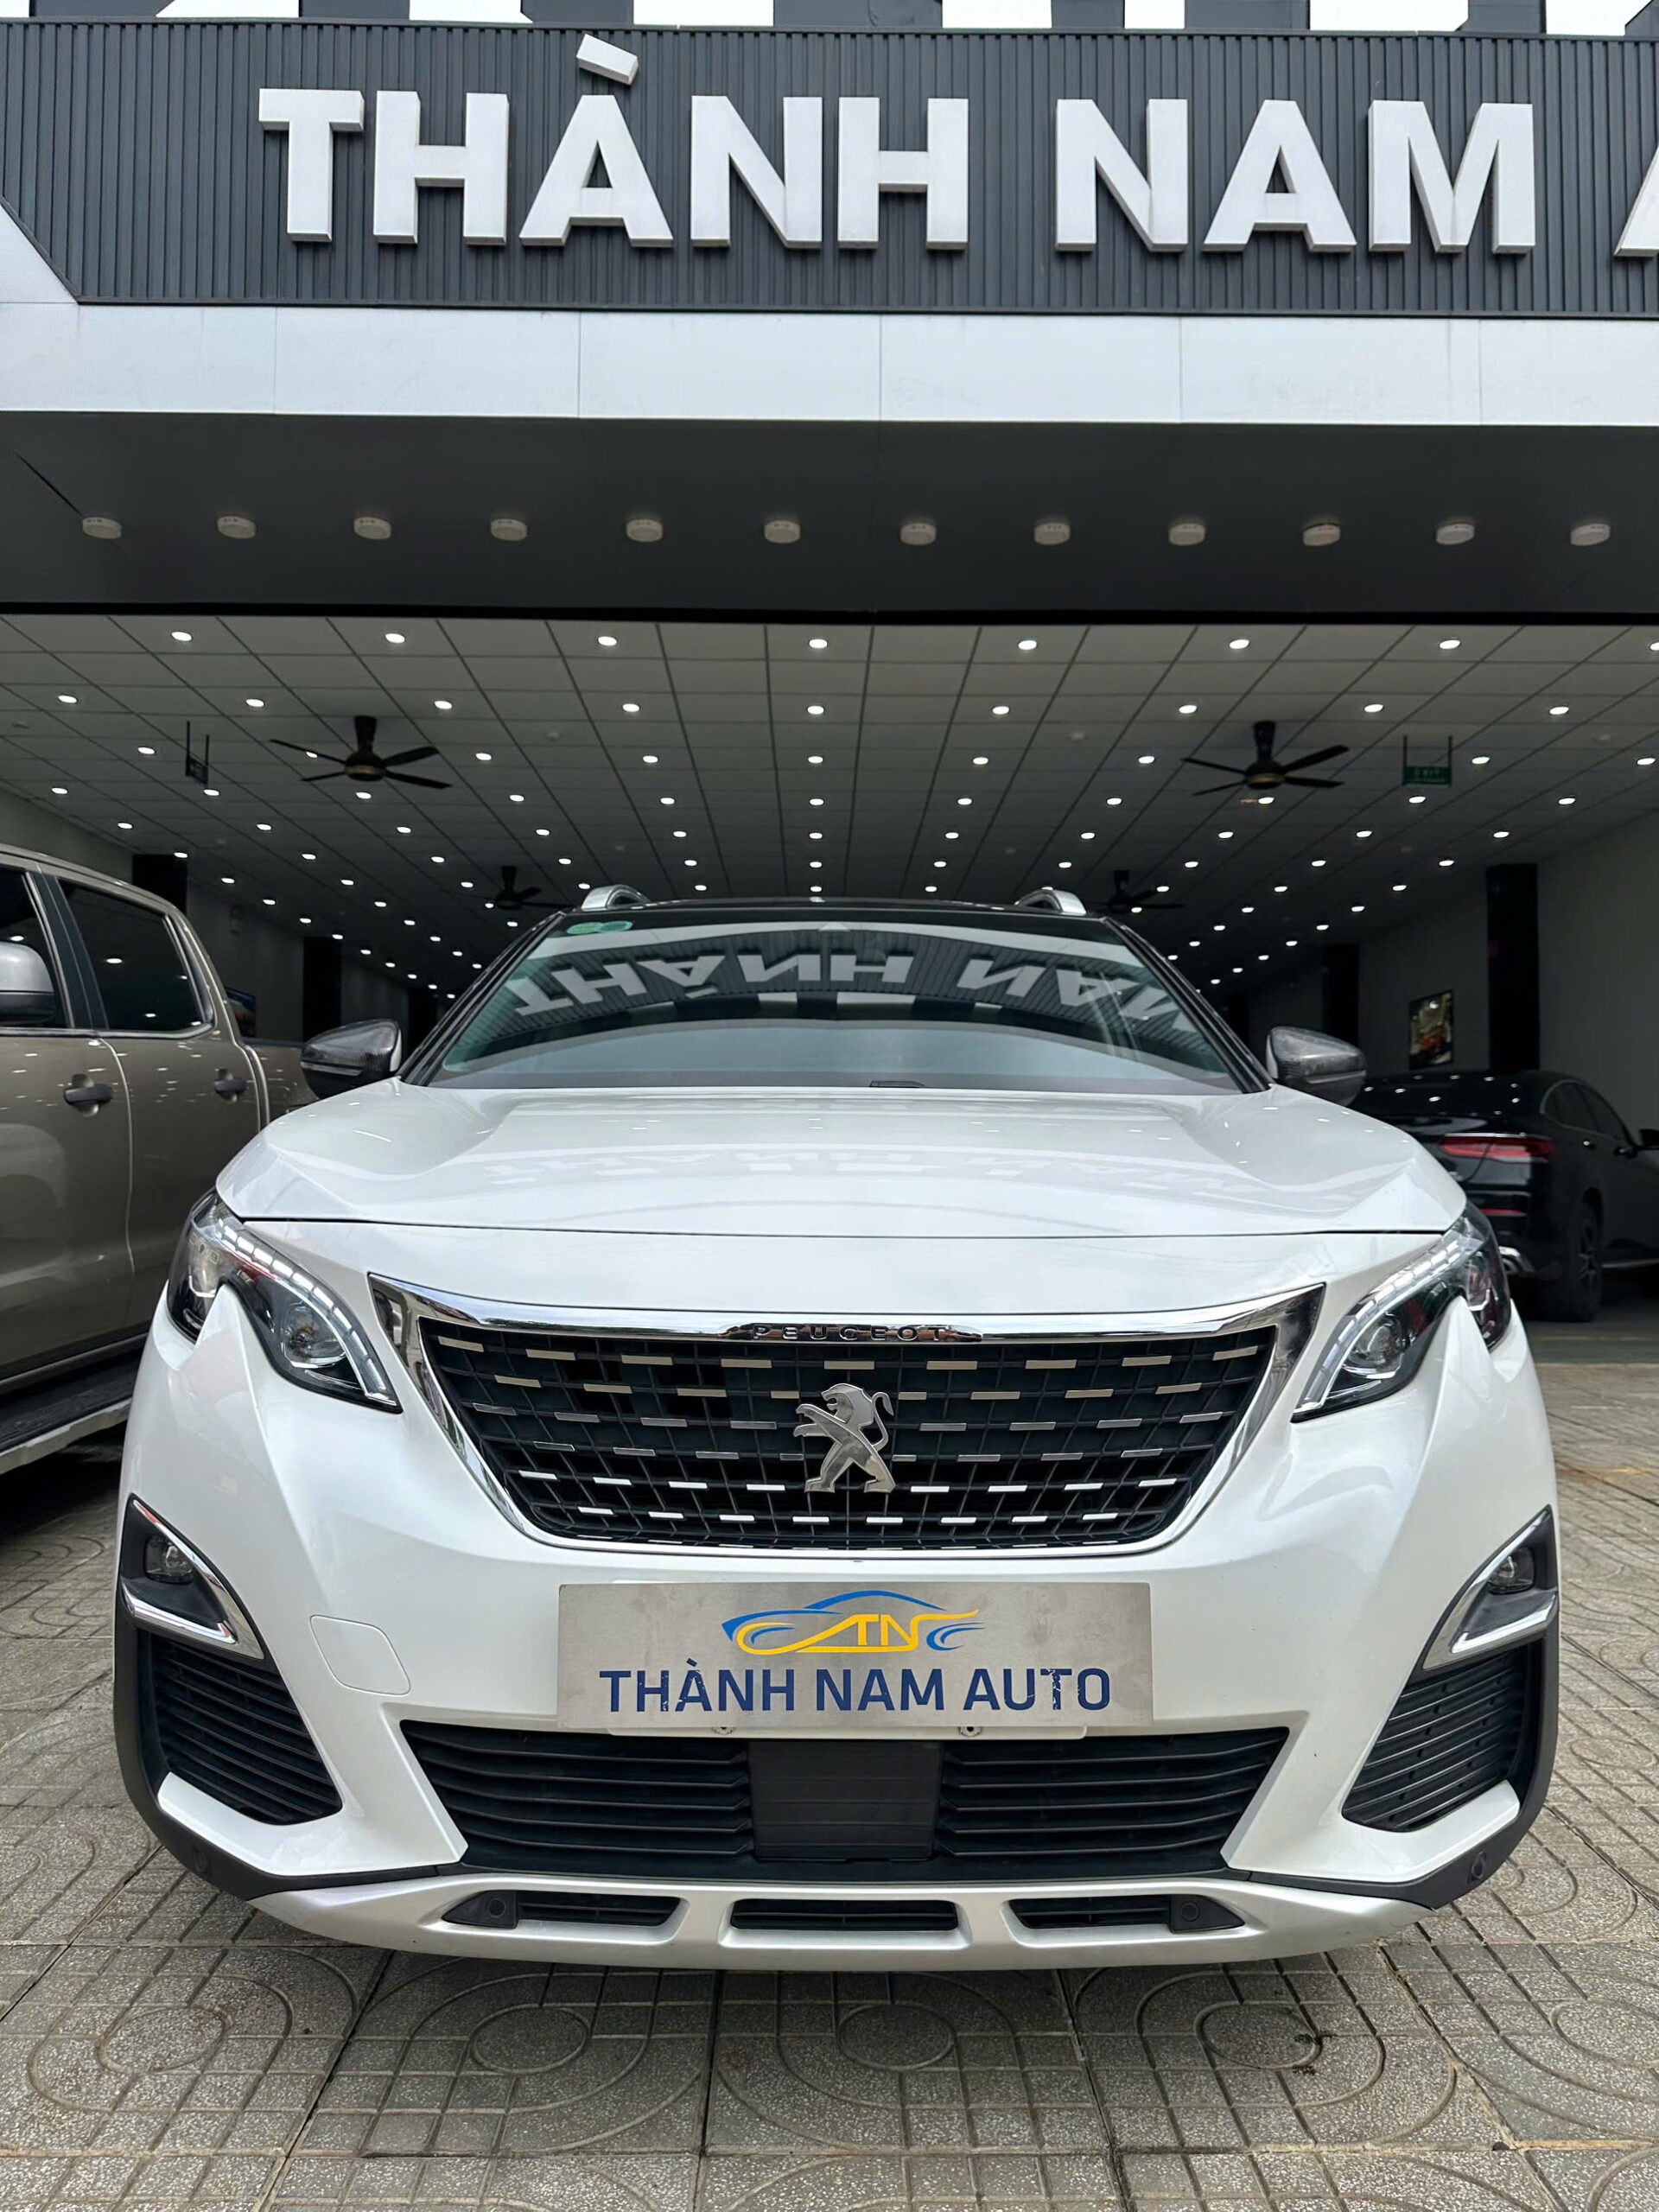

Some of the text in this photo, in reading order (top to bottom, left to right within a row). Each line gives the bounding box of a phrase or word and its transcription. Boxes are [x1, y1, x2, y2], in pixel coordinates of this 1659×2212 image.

[258, 34, 969, 251] THÀNH
[1055, 99, 1536, 255] NAM
[753, 1324, 949, 1342] PEUGEOT
[599, 1657, 1110, 1713] THÀNH NAM AUTO
